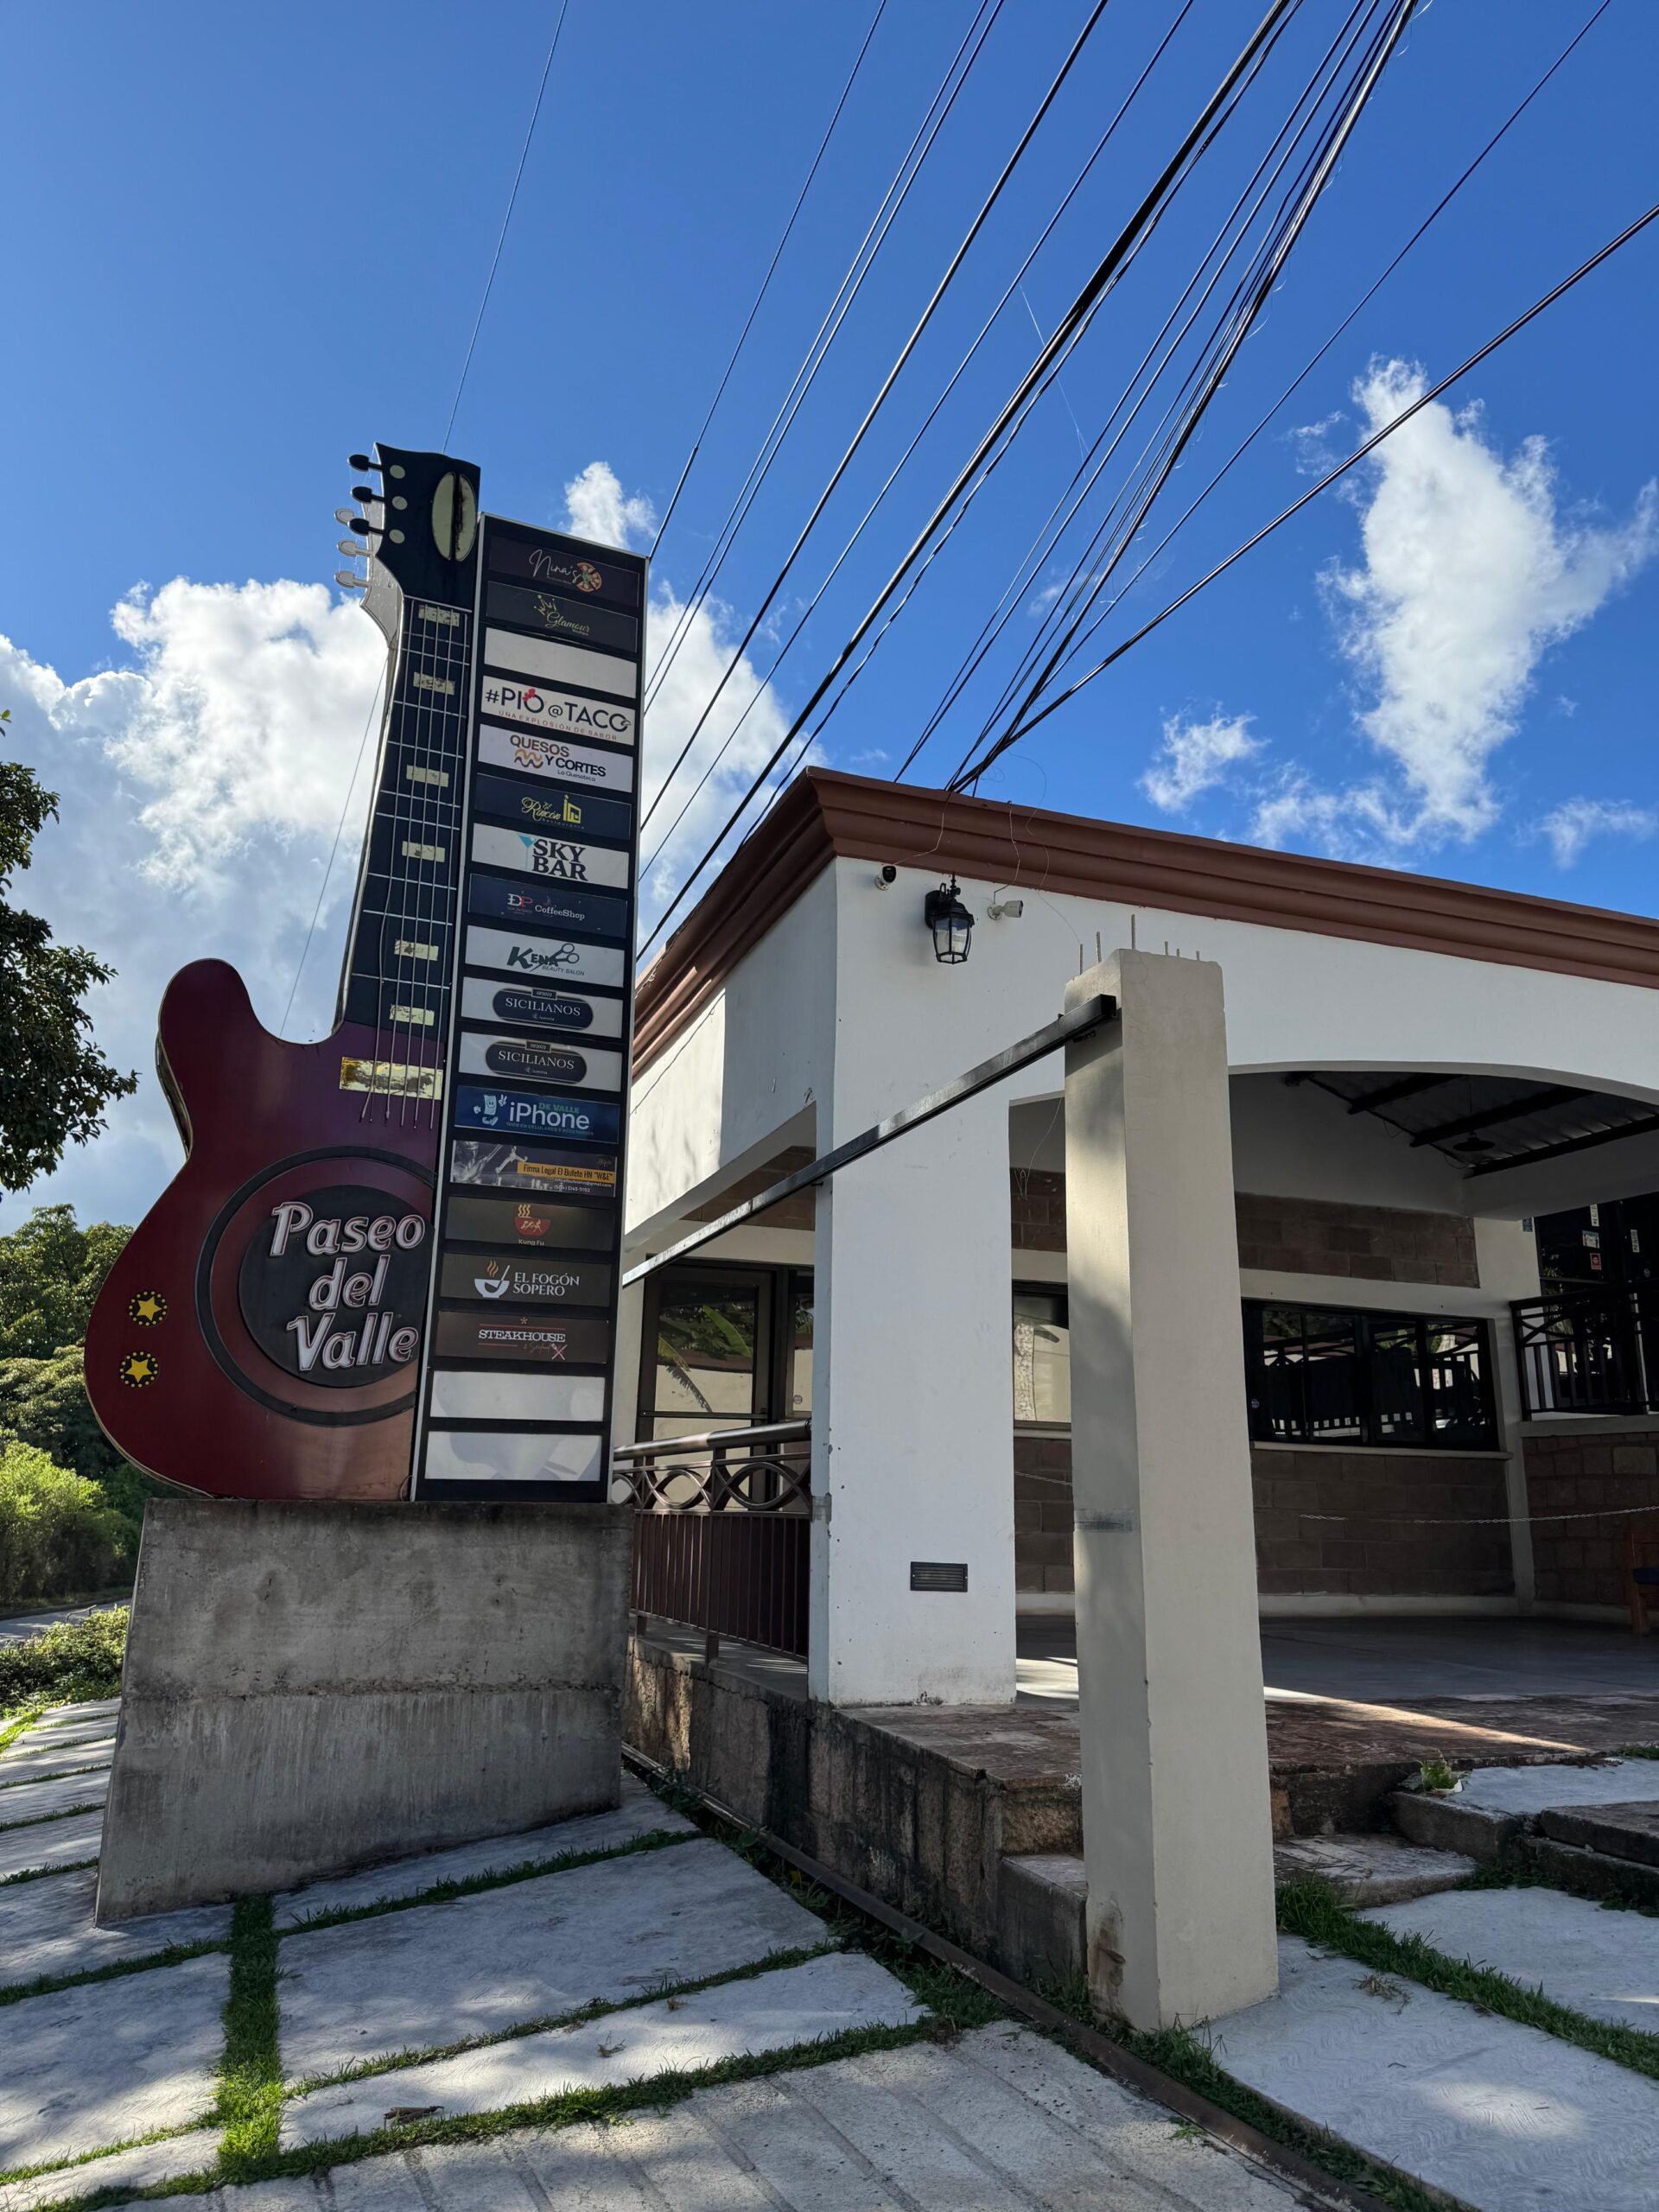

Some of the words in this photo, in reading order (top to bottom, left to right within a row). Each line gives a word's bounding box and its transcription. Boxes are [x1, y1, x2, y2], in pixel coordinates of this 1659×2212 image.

[529, 550, 582, 583] Nina's
[545, 611, 590, 632] Glamour
[499, 710, 517, 719] UNA
[588, 730, 617, 741] SABOR
[510, 734, 569, 757] QUESOS
[544, 754, 554, 766] Y
[556, 757, 607, 777] CORTES
[533, 839, 586, 863] SKY
[532, 855, 588, 881] BAR
[542, 964, 563, 973] BEAUTY
[565, 968, 585, 976] SALON
[505, 997, 581, 1016] SICILIANOS
[499, 1050, 575, 1070] SICILIANOS
[509, 1102, 589, 1130] iPhone
[553, 1104, 580, 1114] VALLE
[524, 1164, 540, 1173] Firma
[541, 1166, 556, 1175] Legal
[564, 1168, 582, 1178] Bufete
[270, 1201, 425, 1256] Paseo
[308, 1255, 391, 1310] del
[512, 1283, 565, 1296] SOPERO
[514, 1272, 529, 1283] EL
[532, 1273, 580, 1287] FOGÓN
[286, 1312, 419, 1370] Valle
[478, 1330, 566, 1343] STEAKHOUSE
